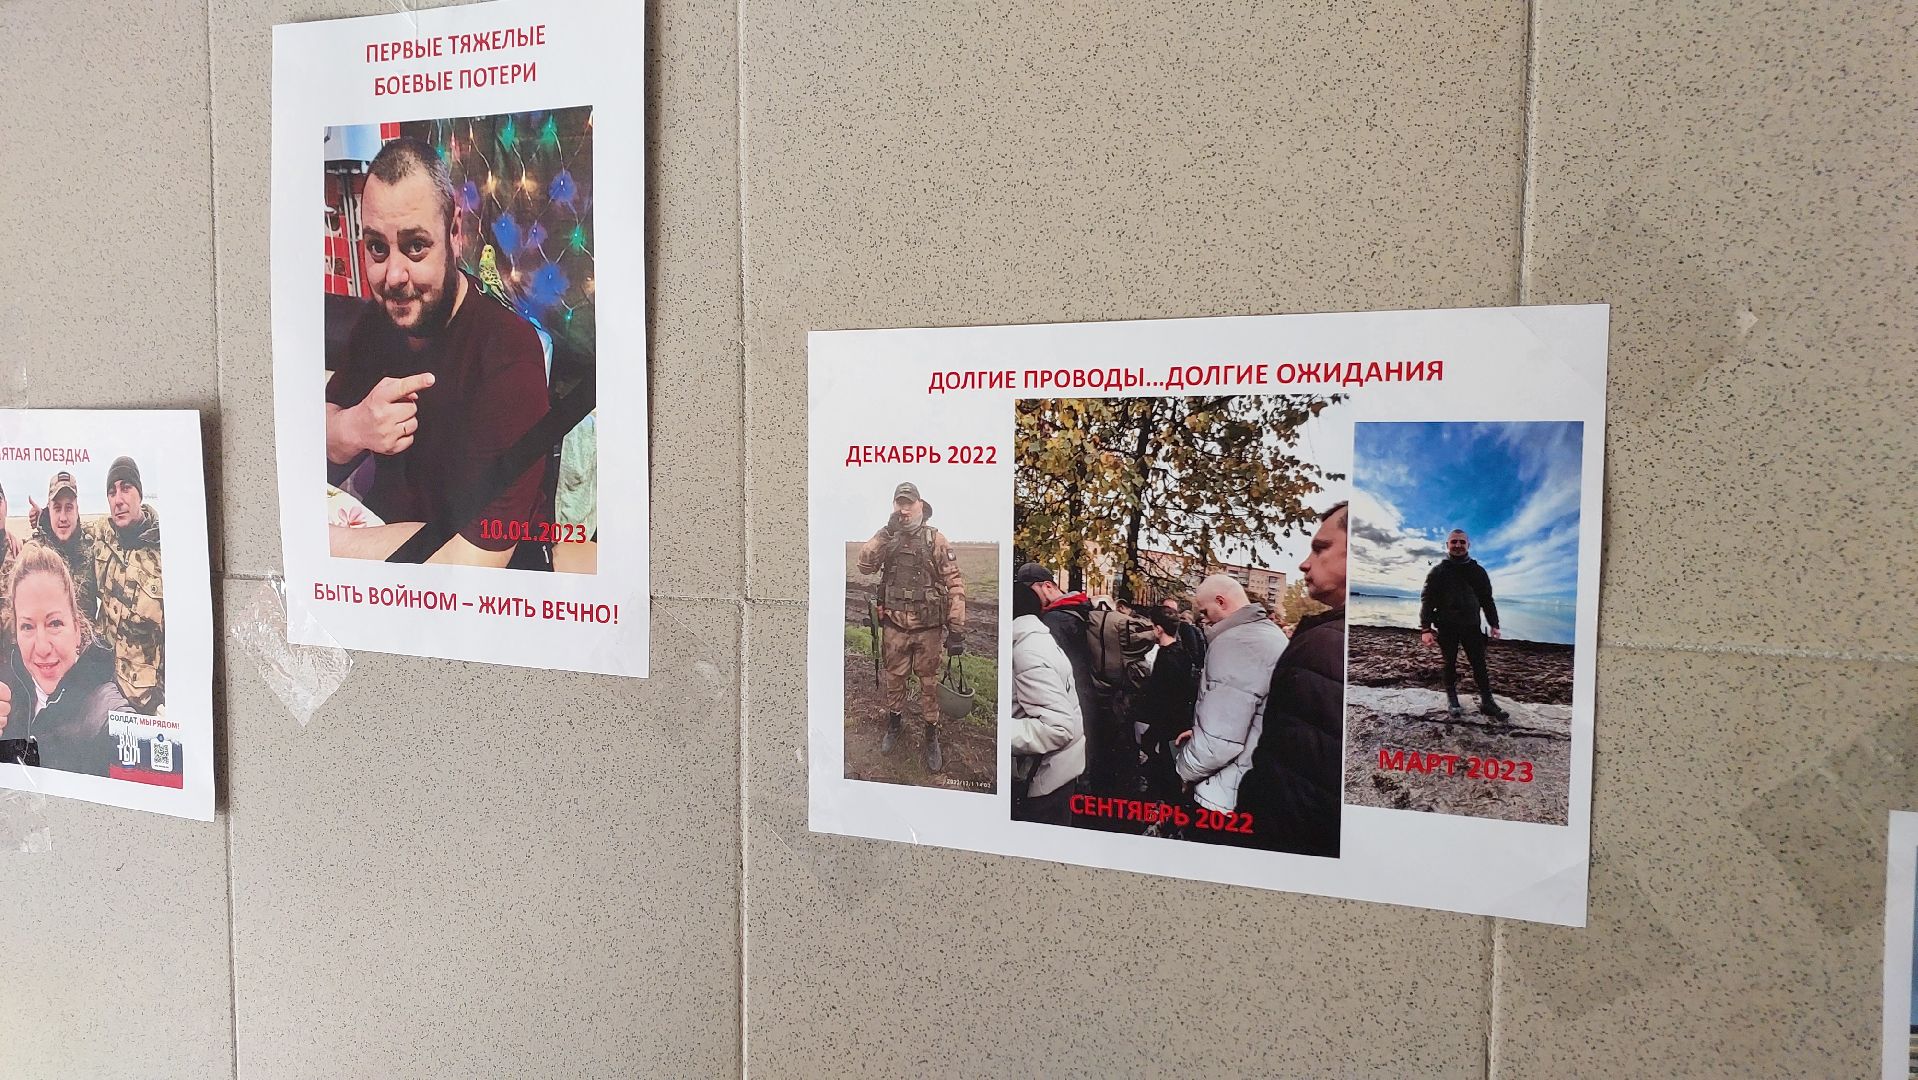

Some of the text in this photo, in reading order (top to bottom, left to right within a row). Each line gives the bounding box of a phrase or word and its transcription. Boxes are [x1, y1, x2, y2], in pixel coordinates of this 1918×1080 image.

[366, 24, 546, 63] ПЕРВЫЕ ТЯЖЕЛЫЕ
[374, 62, 537, 97] БОЕВЫЕ ПОТЕРИ
[928, 370, 1017, 394] ДОЛГИЕ
[1275, 359, 1444, 385] ОЖИДАНИЯ
[0, 447, 91, 466] ЯТАЯ ПОЕЗДКА
[845, 445, 997, 467] ДЕКАБРЬ 2022
[479, 518, 587, 544] 10.01.2023
[314, 582, 363, 605] БЫТЬ
[368, 584, 457, 612] ВОЙНОМ
[478, 595, 536, 618] ЖИТЬ
[542, 600, 619, 625] ВЕЧНО!
[109, 714, 180, 730] СОЛДАТ, МЫ РЯДОМ!
[1378, 749, 1535, 784] МАРТ 2023
[1068, 793, 1255, 835] СЕНТЯБРЬ 2022
